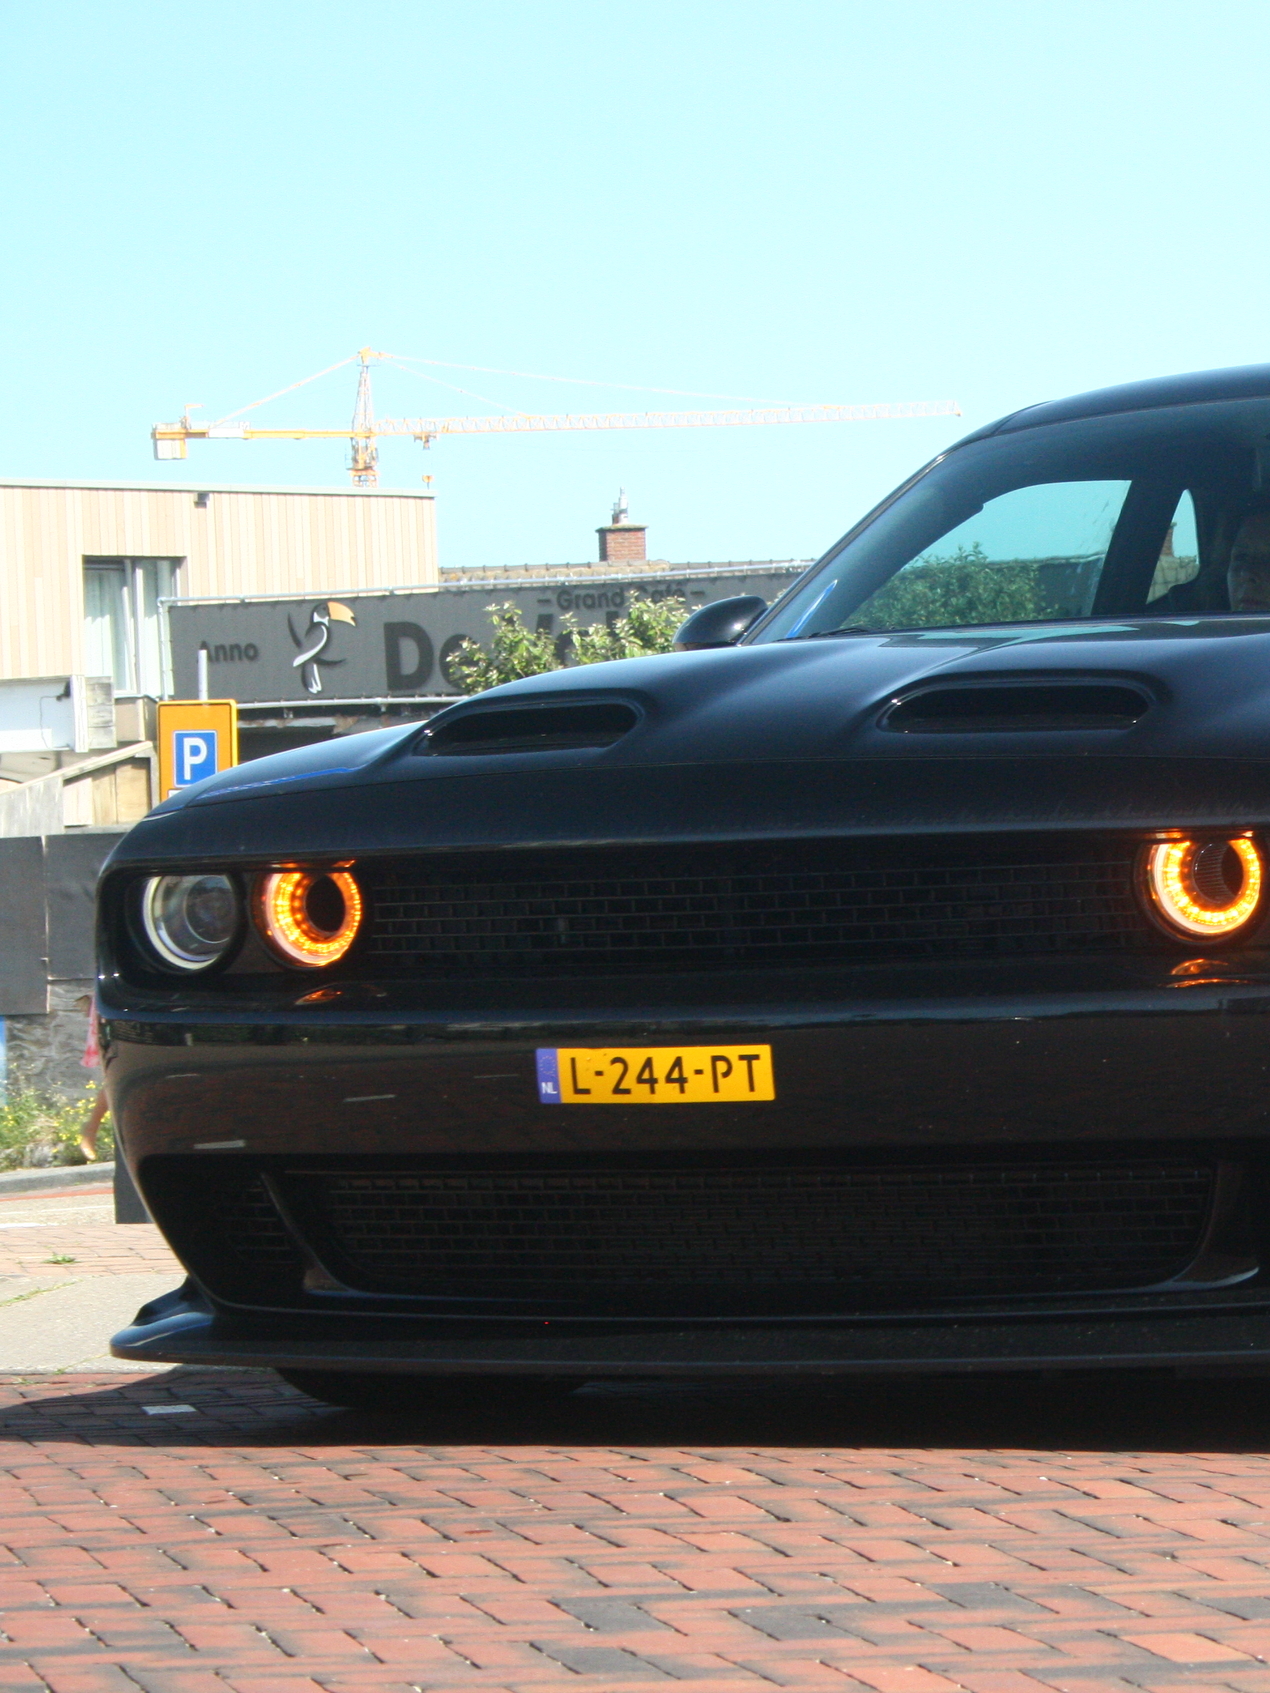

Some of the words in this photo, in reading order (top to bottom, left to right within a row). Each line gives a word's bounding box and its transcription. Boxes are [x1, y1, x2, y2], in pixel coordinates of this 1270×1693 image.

[556, 587, 625, 611] Grand
[197, 640, 259, 662] Anno
[183, 737, 208, 780] P
[570, 1054, 761, 1095] L-244-PT
[541, 1082, 558, 1094] NL
